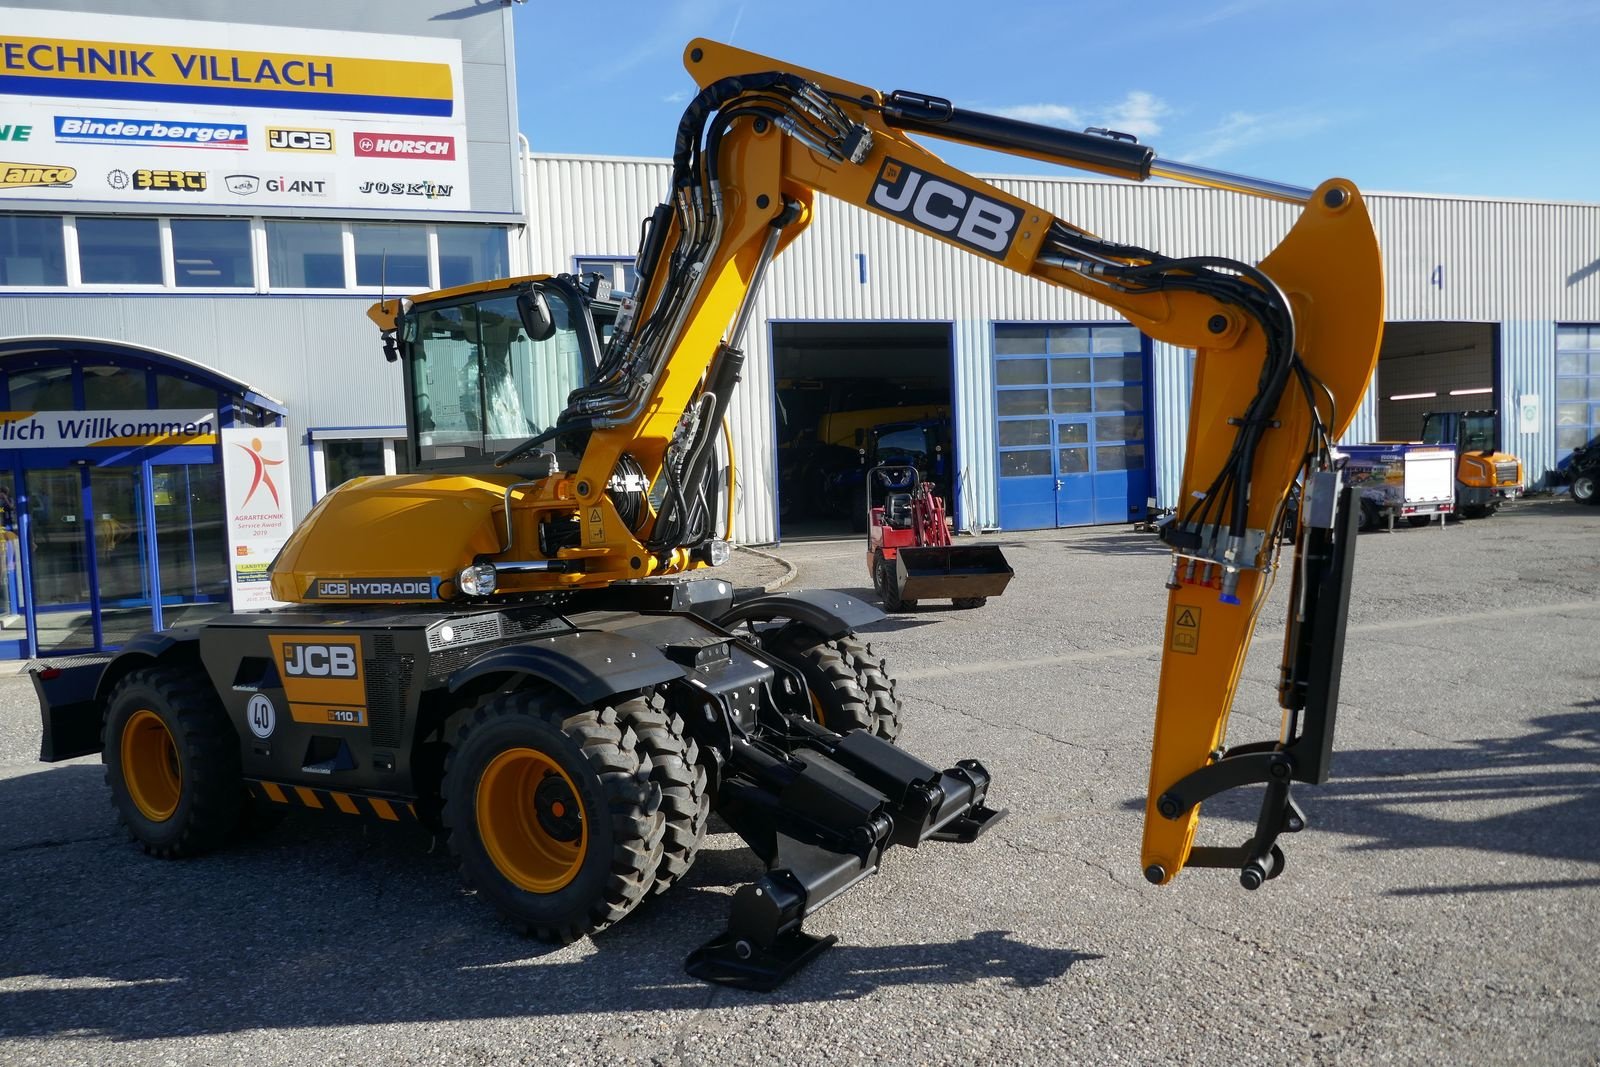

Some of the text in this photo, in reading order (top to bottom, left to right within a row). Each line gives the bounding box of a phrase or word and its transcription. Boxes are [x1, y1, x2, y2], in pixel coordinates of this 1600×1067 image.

[0, 43, 333, 88] ECHNIK VILLACH
[61, 119, 243, 141] Binderberger
[270, 130, 331, 150] JCB
[375, 139, 449, 155] HORSCH
[359, 181, 453, 197] JOSKIN
[874, 171, 1016, 252] JCB
[0, 417, 212, 441] lich Willkommen
[235, 513, 284, 521] AGRARTECHNIK
[320, 582, 431, 594] JCB HYDRADIG
[285, 645, 356, 677] JCB
[254, 702, 269, 729] 40
